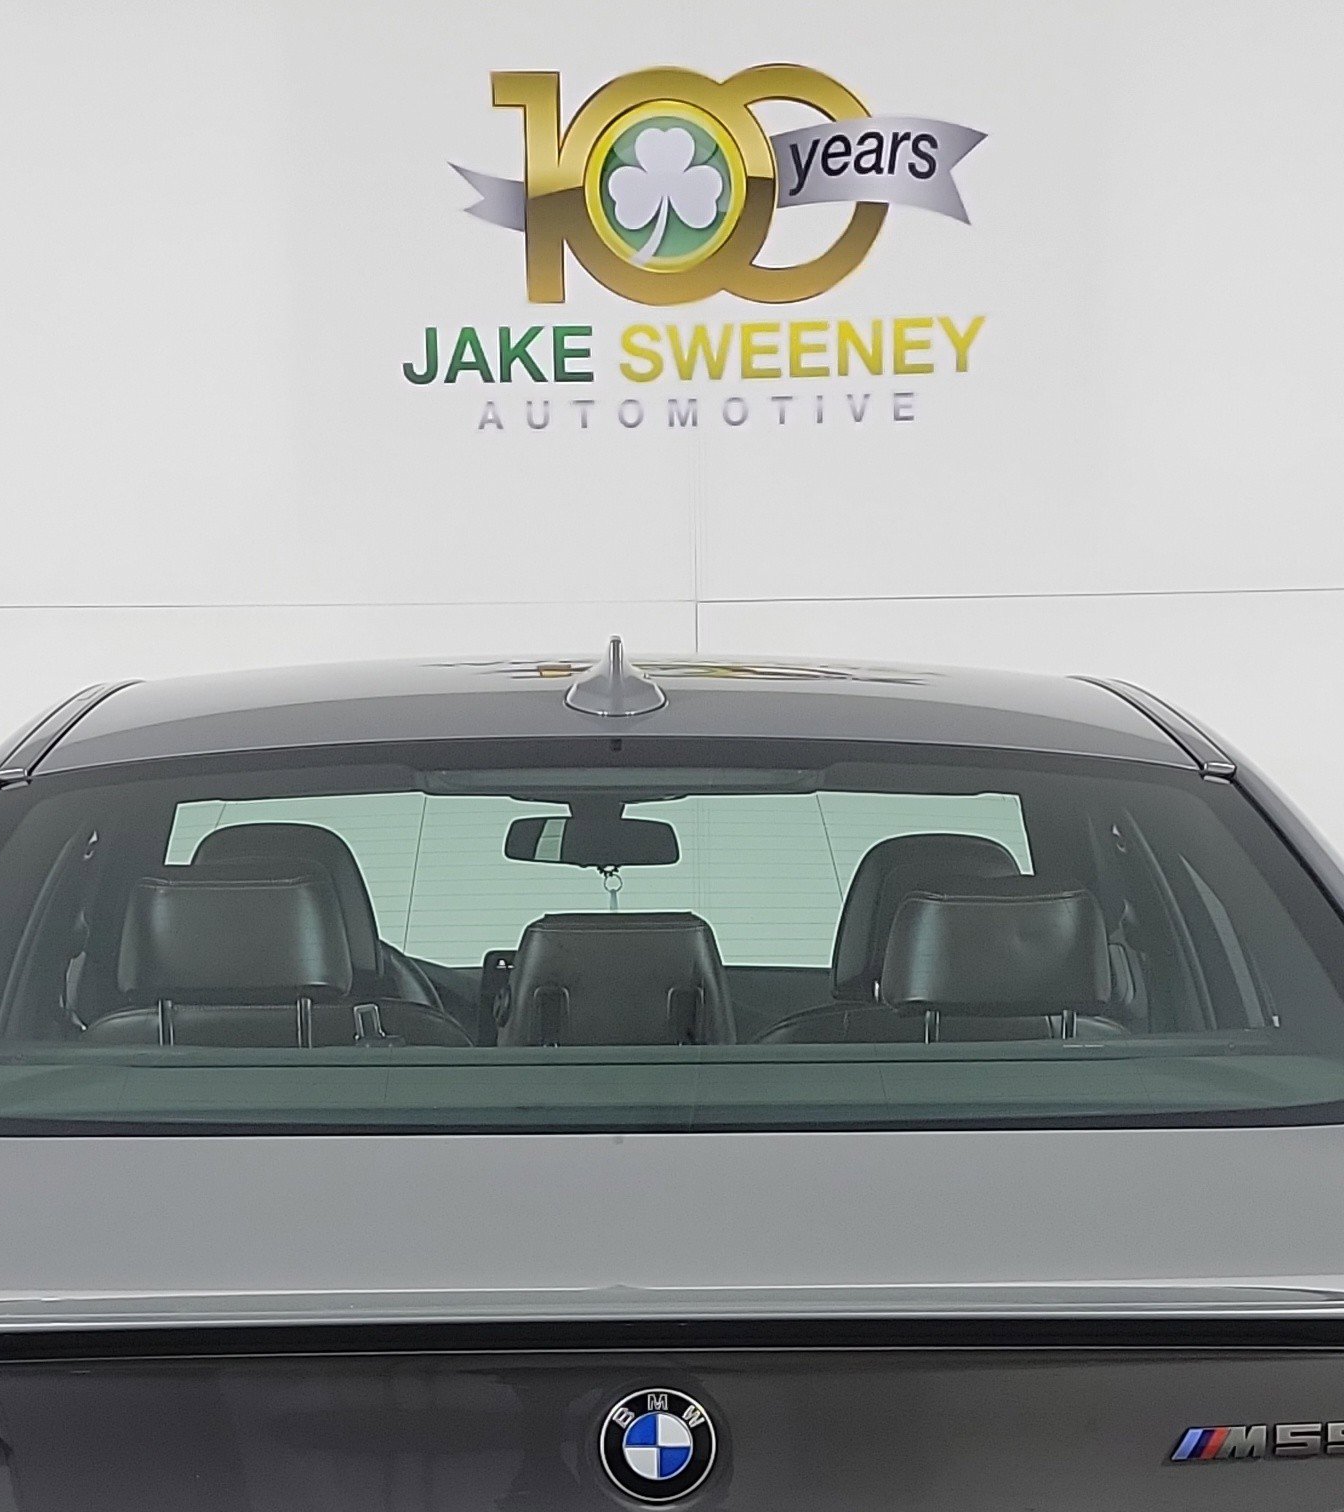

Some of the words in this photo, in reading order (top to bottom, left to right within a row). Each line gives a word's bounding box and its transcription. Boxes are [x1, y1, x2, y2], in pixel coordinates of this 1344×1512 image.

[491, 64, 888, 305] 100
[788, 131, 937, 195] years
[403, 325, 593, 384] JAKE
[620, 317, 986, 382] SWEENEY
[479, 393, 916, 430] AUTOMOTIVE
[612, 1393, 706, 1429] BMW
